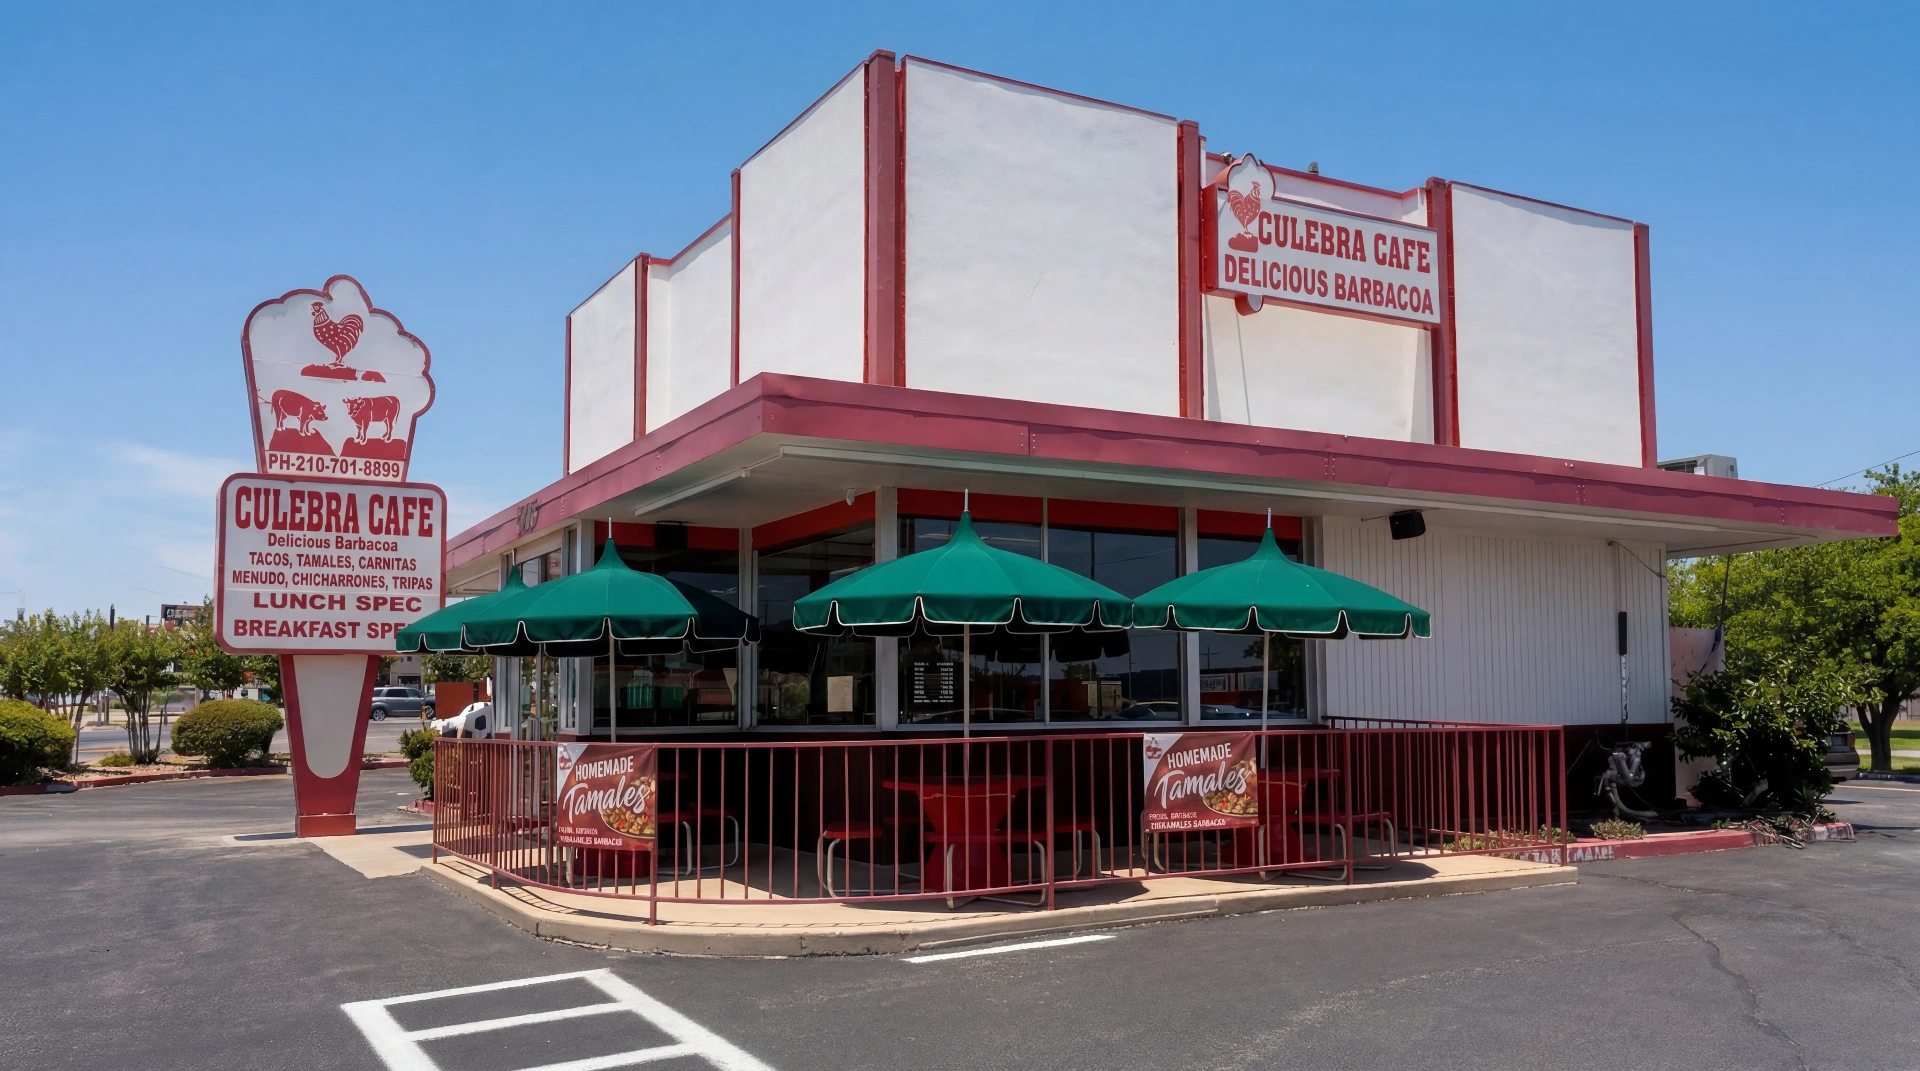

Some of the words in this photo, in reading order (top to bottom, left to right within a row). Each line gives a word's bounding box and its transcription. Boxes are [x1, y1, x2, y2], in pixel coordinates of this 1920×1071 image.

[1258, 211, 1367, 262] CULEBRA
[1373, 232, 1431, 274] CAFE
[1224, 253, 1329, 298] DELICIOUS
[1334, 272, 1434, 315] BARBACOA
[268, 454, 400, 478] PH-210-701-8899
[235, 486, 360, 534] CULEBRA
[368, 493, 434, 538] CAFE
[267, 532, 331, 549] Delicious
[335, 535, 398, 552] Barbacoa
[249, 551, 293, 569] TACOS,
[296, 553, 355, 571] TAMALES,
[358, 556, 417, 571] CARNITAS
[232, 570, 288, 588] MENUDO,
[292, 572, 389, 591] CHICHARRONES,
[392, 576, 433, 590] TRIPAS
[253, 592, 346, 611] LUNCH
[355, 595, 422, 613] SPEC
[233, 619, 361, 639] BREAKFAST
[575, 755, 634, 782] HOMEMADE
[1167, 742, 1233, 769] HOMEMADE
[1153, 760, 1253, 809] Tamales
[562, 775, 651, 824] Tamales
